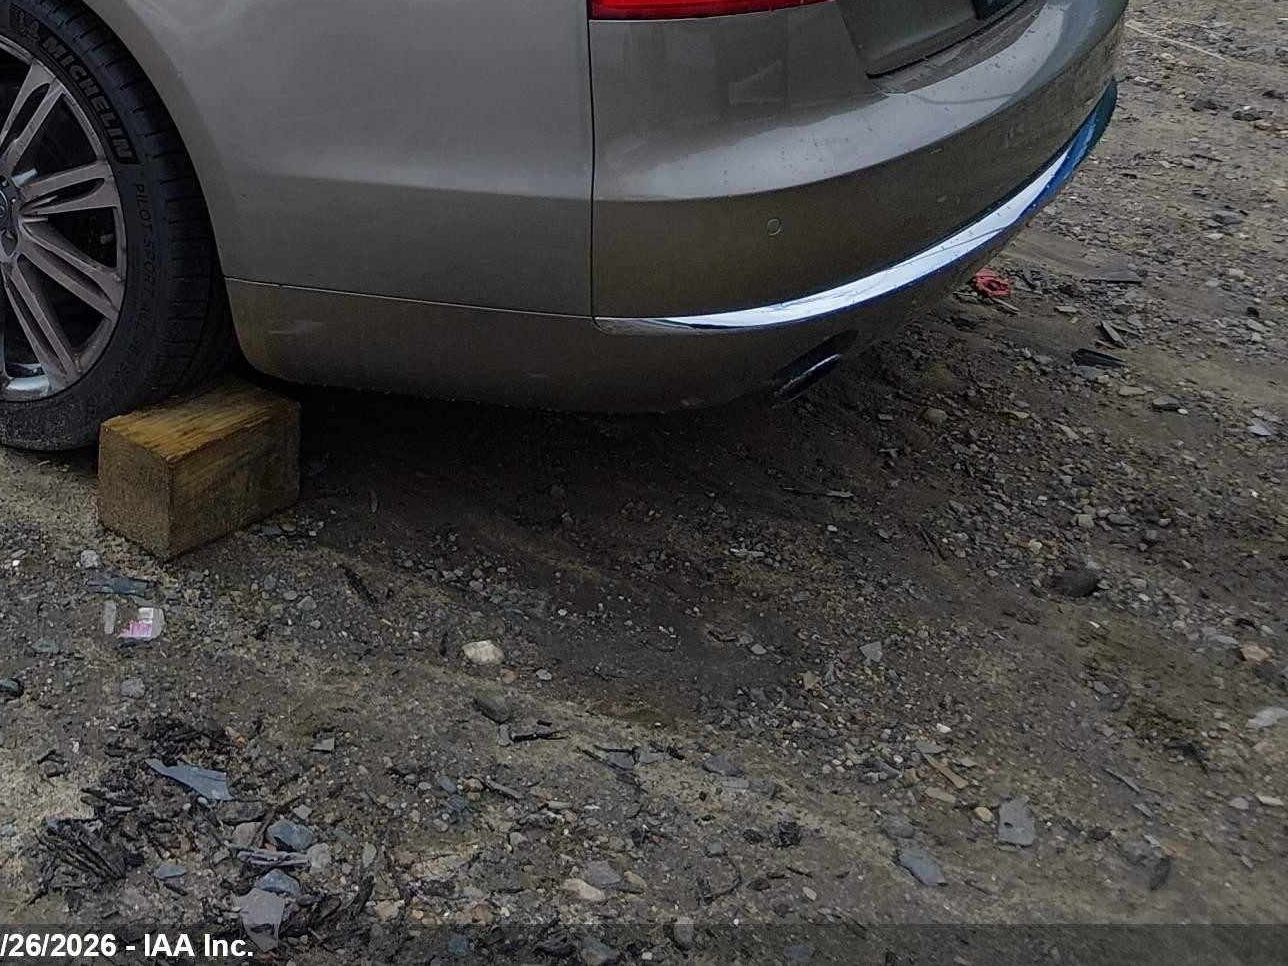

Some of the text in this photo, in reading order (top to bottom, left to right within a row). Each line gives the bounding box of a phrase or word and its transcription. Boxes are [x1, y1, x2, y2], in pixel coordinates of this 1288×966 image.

[42, 36, 133, 158] MICHELIN
[134, 183, 152, 233] PILOT
[143, 238, 155, 297] SPORT
